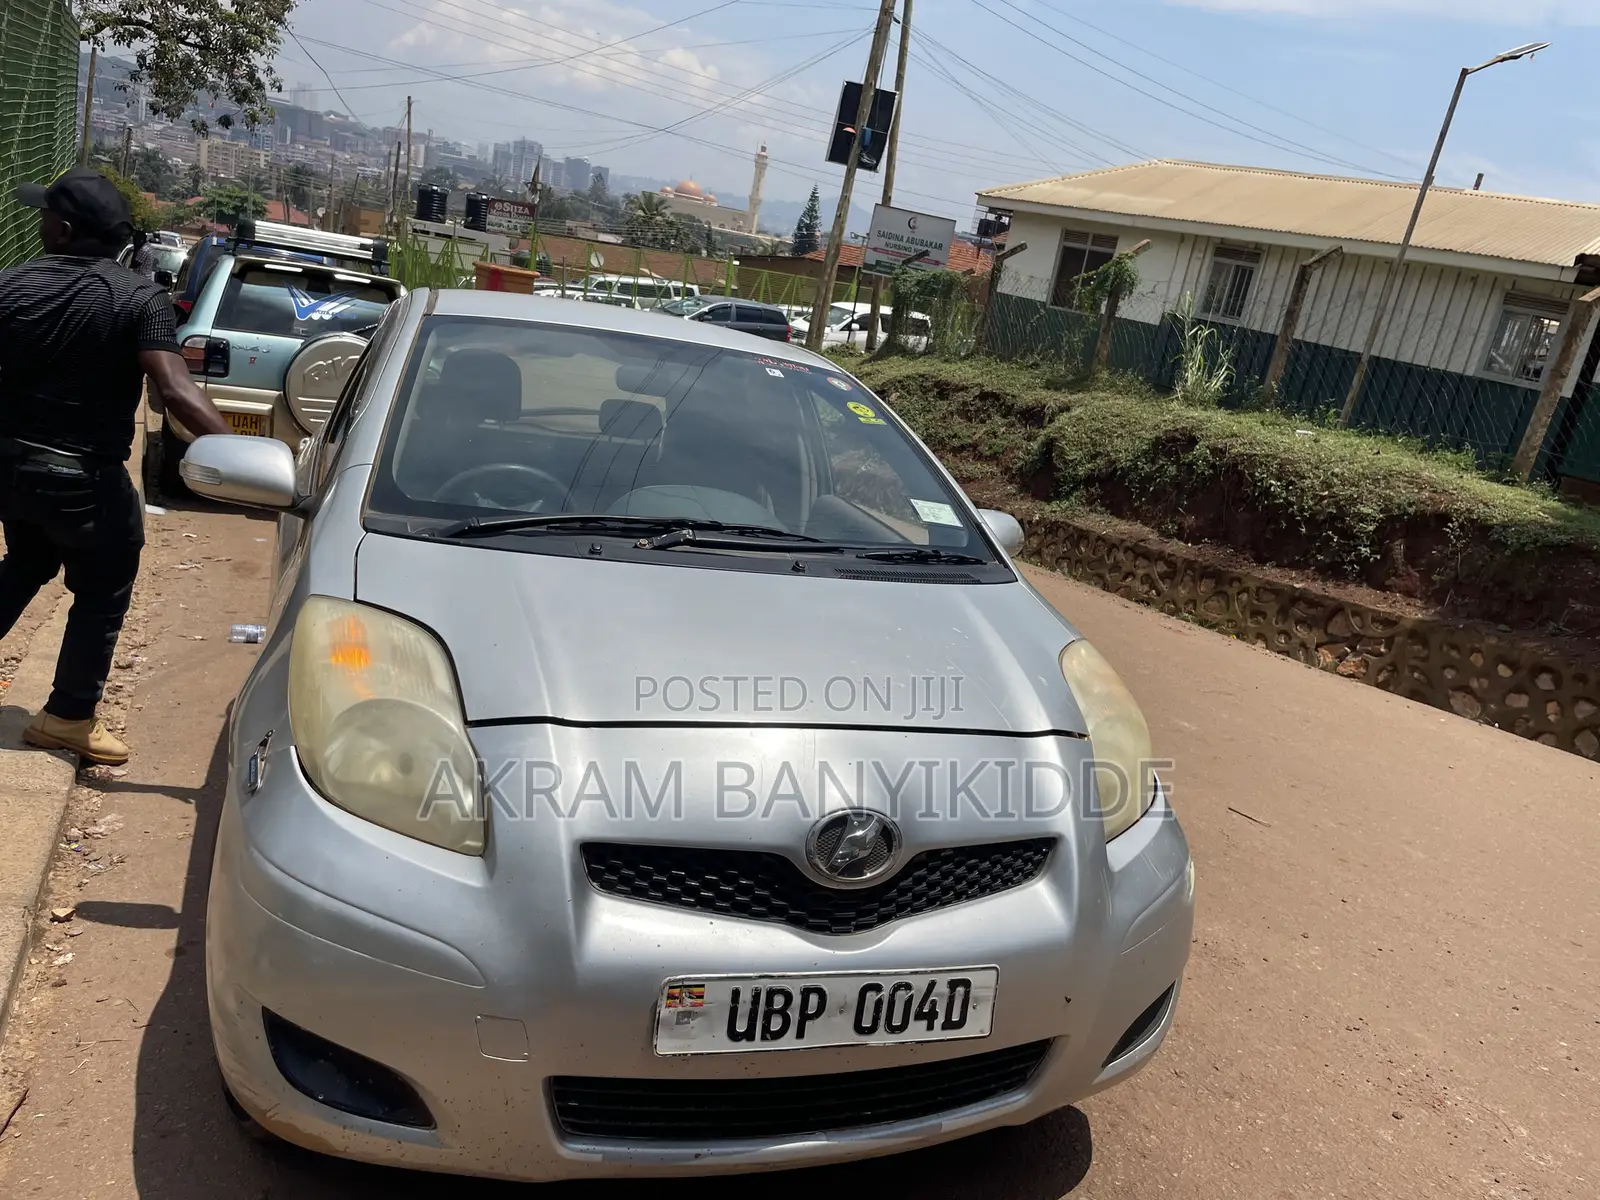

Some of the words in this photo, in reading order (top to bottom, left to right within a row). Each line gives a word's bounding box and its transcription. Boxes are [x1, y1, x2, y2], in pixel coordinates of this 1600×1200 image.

[877, 230, 904, 243] SAIDINA
[905, 236, 944, 251] ABUBAKAR
[884, 241, 912, 254] NURSING
[232, 415, 258, 430] UAH
[726, 983, 828, 1043] UBP
[853, 977, 973, 1035] 004D
